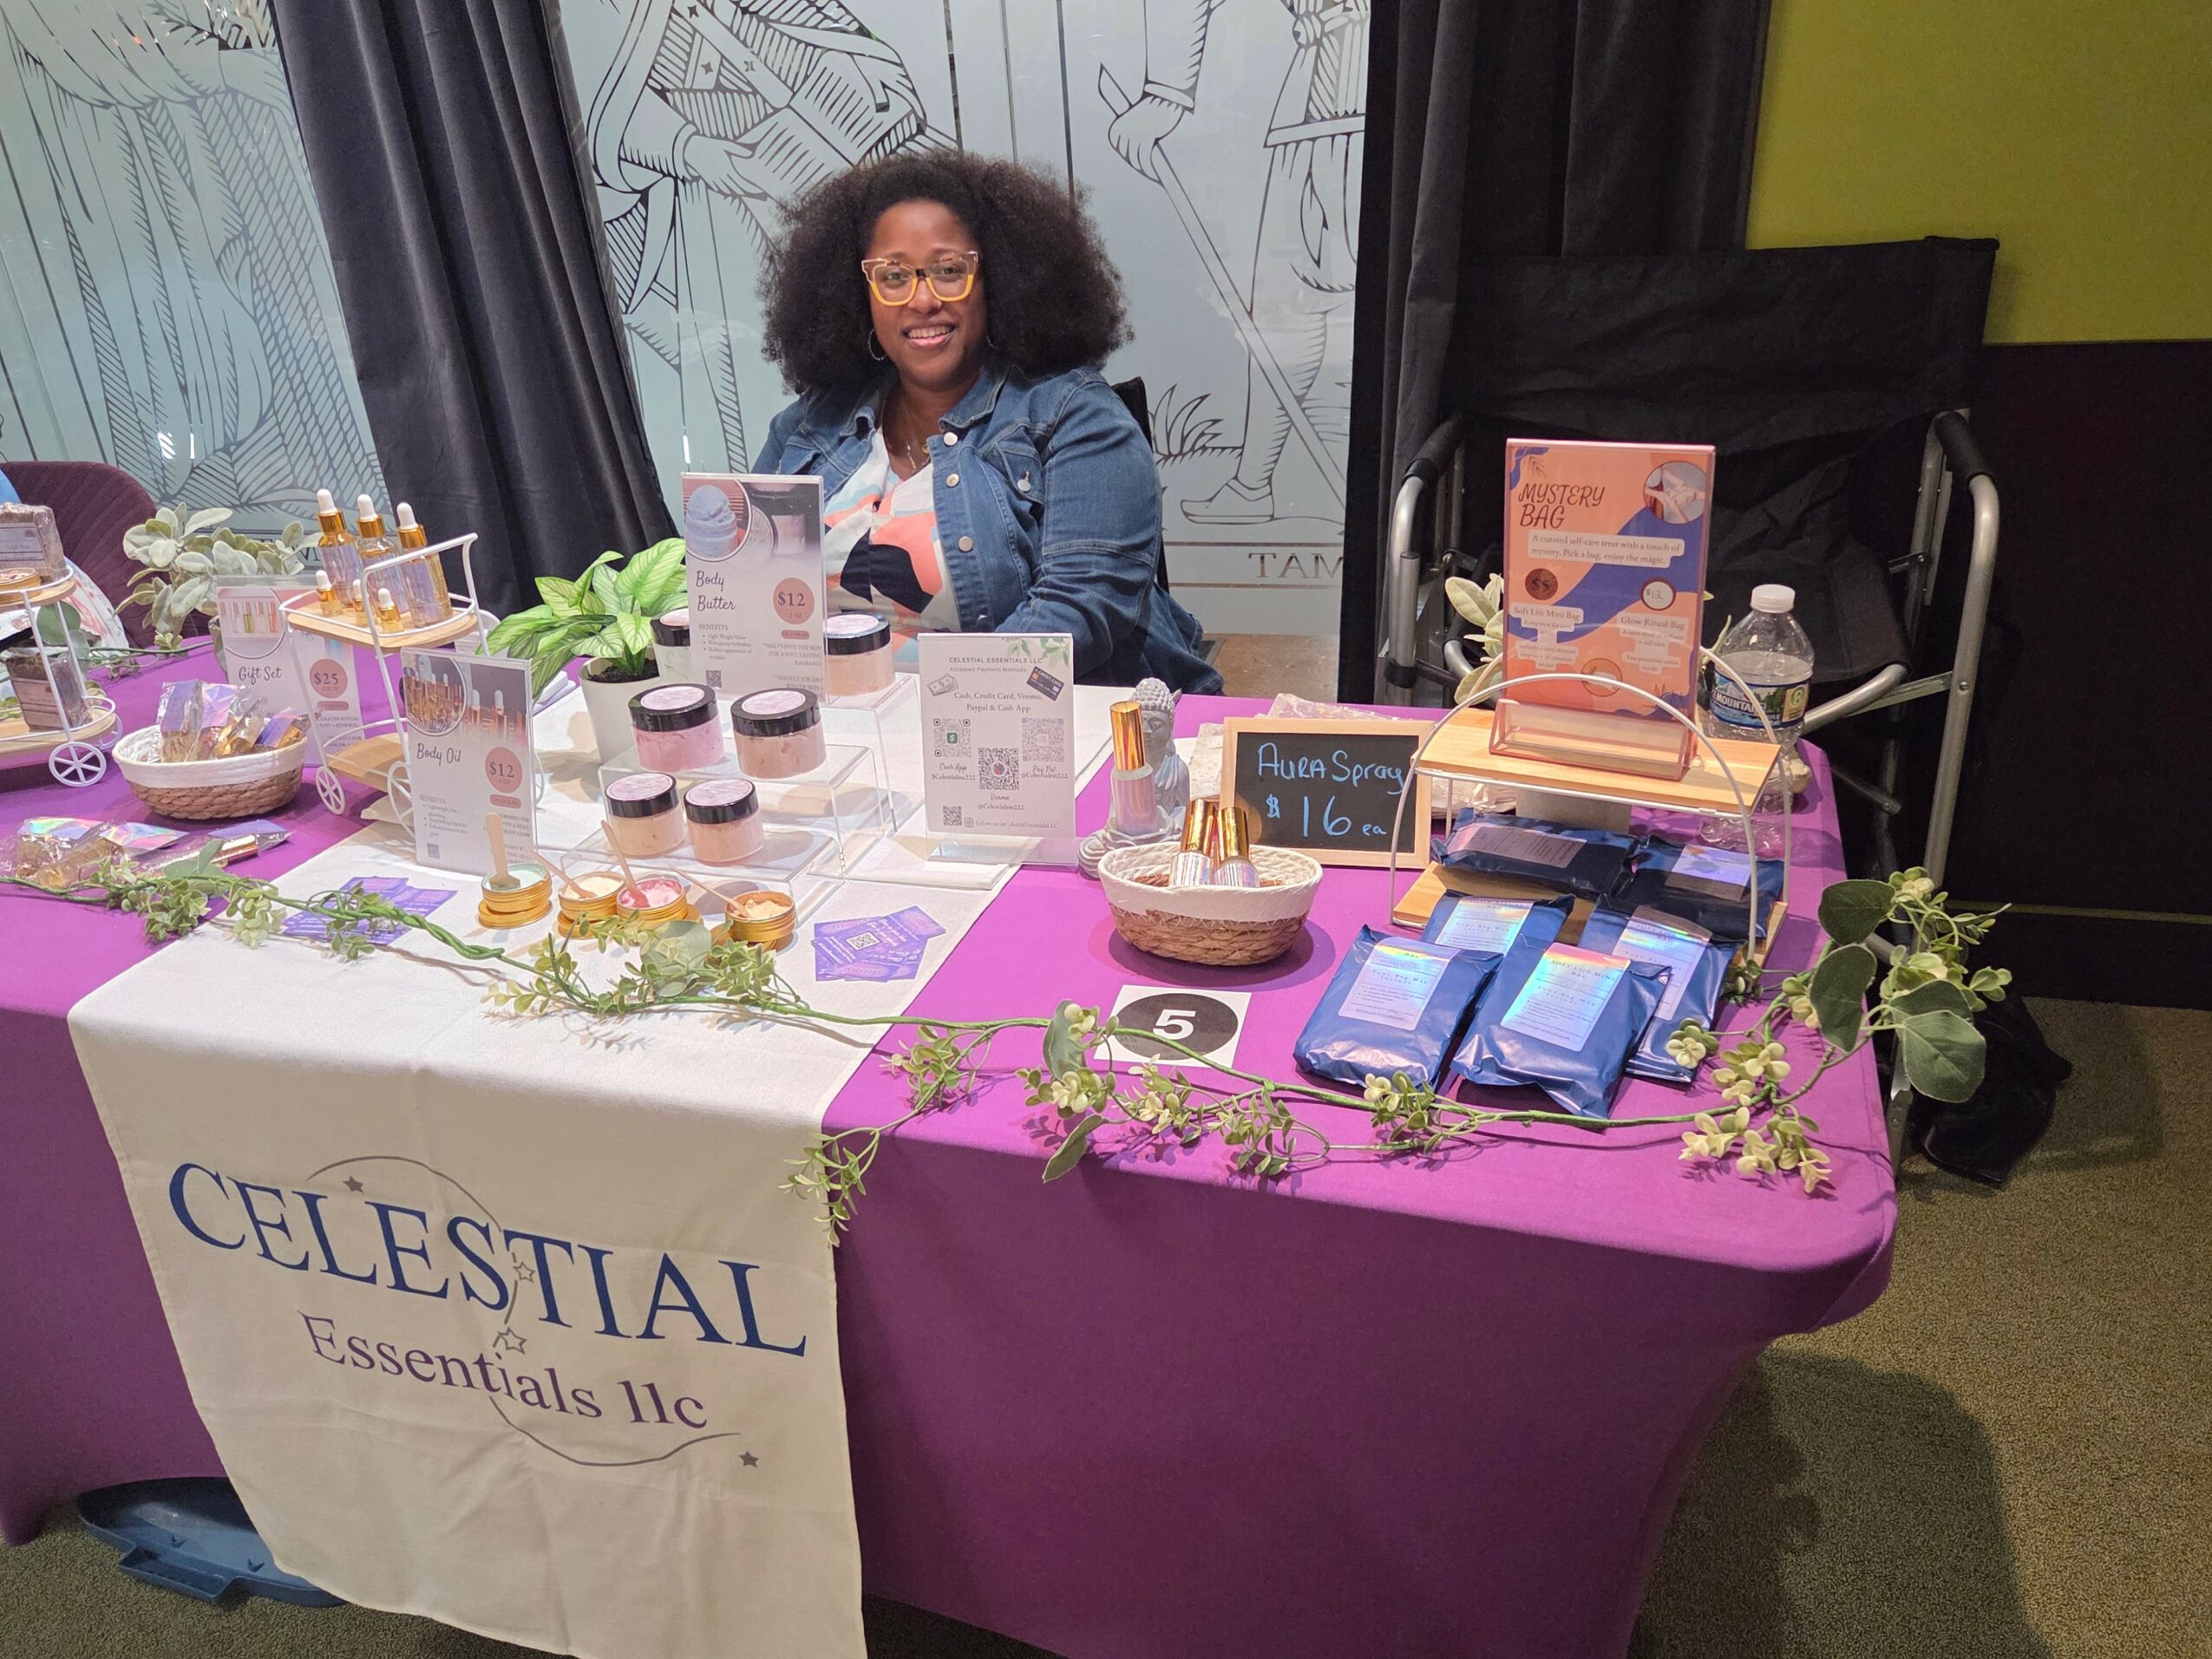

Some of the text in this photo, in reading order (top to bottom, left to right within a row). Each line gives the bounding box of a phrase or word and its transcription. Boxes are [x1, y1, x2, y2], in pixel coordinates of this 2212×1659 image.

[1519, 483, 1606, 507] MYSTERY
[1520, 503, 1565, 529] BAG
[1540, 536, 1568, 545] curated
[1569, 537, 1601, 547] self-care
[1601, 539, 1620, 548] treat
[1620, 540, 1639, 549] with
[1646, 542, 1671, 551] touch
[1671, 542, 1682, 552] of
[1531, 548, 1562, 558] mystery.
[1563, 548, 1580, 558] Pick
[1587, 550, 1602, 561] bag,
[1603, 552, 1624, 564] enjoy
[1626, 552, 1639, 562] the
[1640, 555, 1666, 566] magic.
[696, 570, 725, 592] Body
[697, 595, 736, 611] Butter
[777, 591, 806, 607] $12
[1514, 605, 1580, 621] Soft Life Mini Bag
[1620, 617, 1685, 631] Glow Ritual Bag
[239, 666, 283, 685] Gift Set
[314, 672, 339, 685] $25
[954, 692, 972, 701] Cash,
[997, 692, 1016, 701] Card,
[966, 703, 988, 713] Paypal
[1016, 704, 1031, 714] App
[416, 742, 461, 767] Body Oil
[489, 761, 514, 778] $12
[1332, 749, 1405, 795] Spray
[1361, 824, 1388, 837] ea
[1152, 1009, 1196, 1040] 5
[168, 1162, 807, 1358] CELESTIAL
[298, 1310, 708, 1430] Essentials llc
